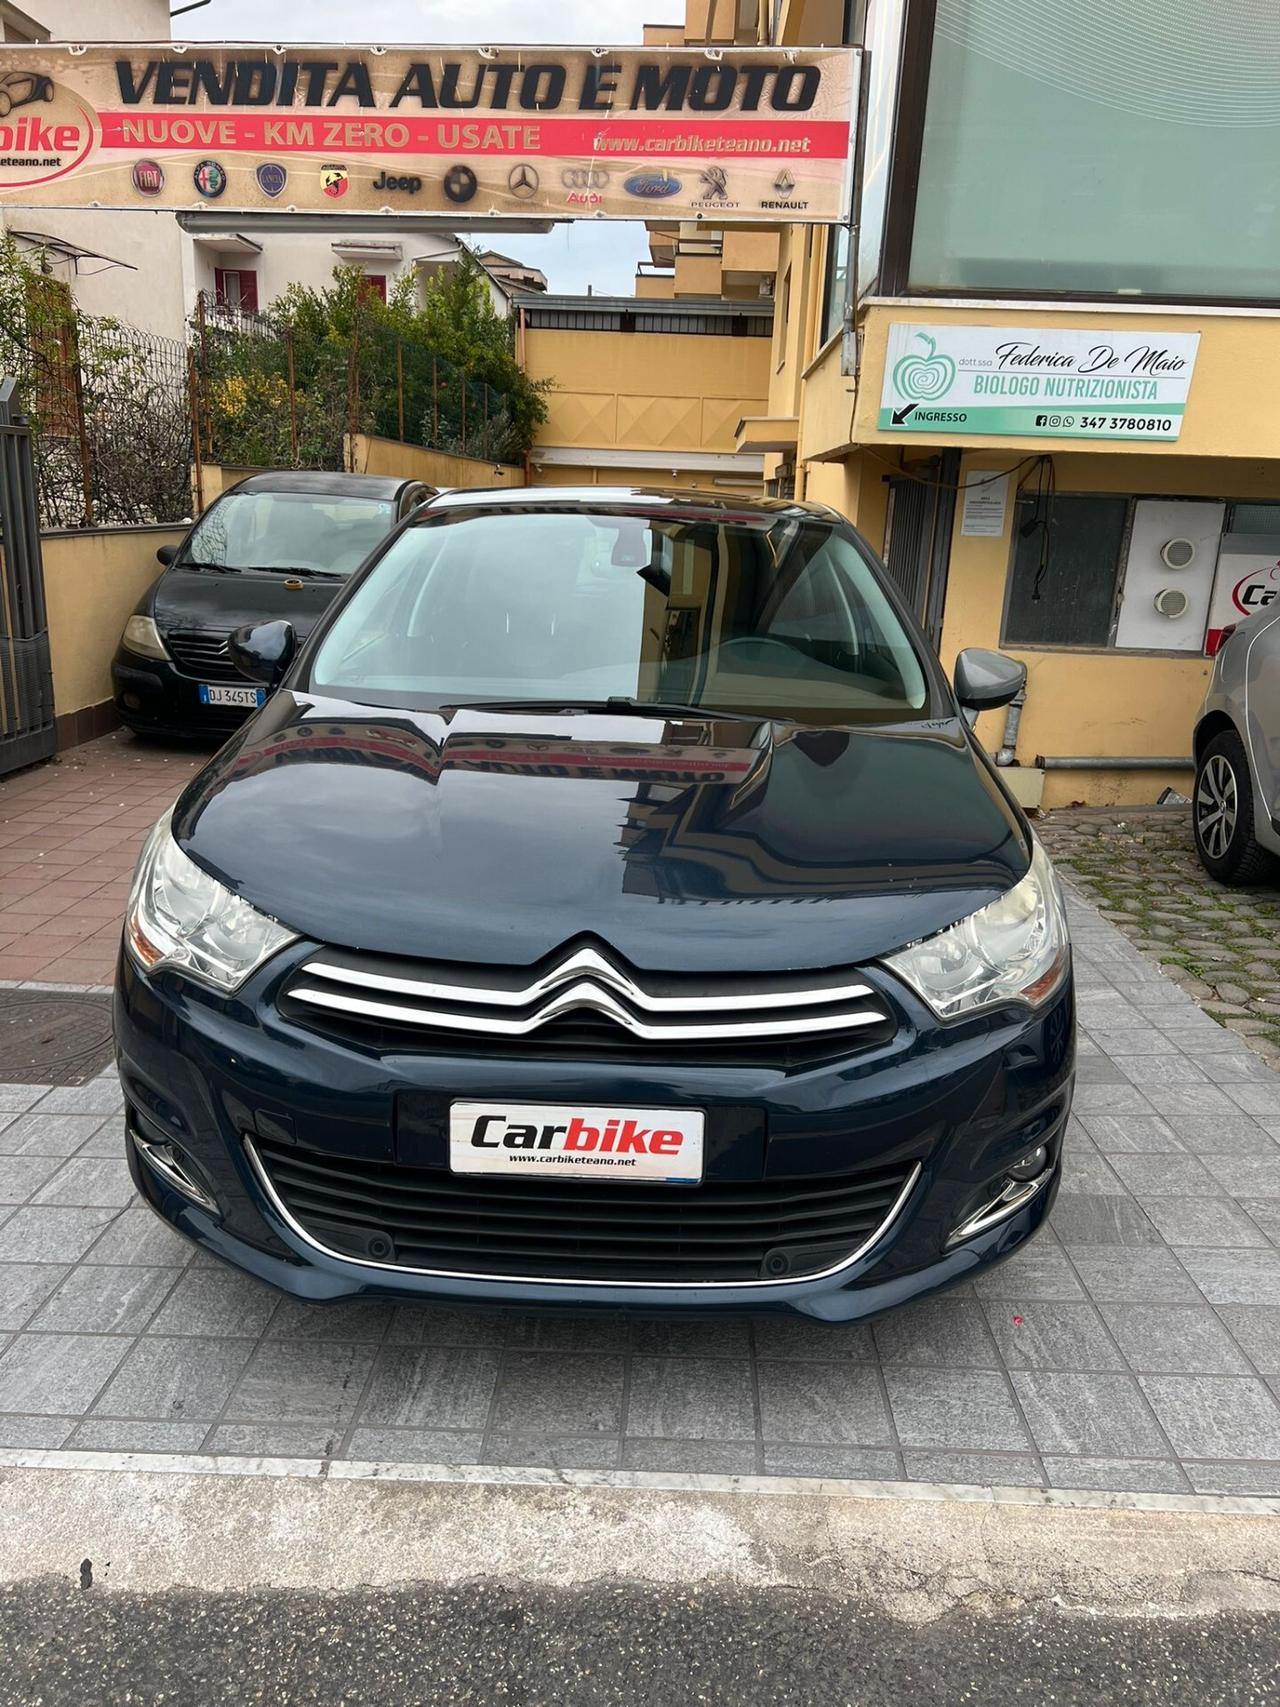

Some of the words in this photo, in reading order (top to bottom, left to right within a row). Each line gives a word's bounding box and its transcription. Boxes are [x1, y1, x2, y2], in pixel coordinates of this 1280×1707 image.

[115, 61, 377, 108] VENDITA
[390, 63, 567, 110] AUTO
[579, 65, 622, 110] E
[630, 65, 821, 111] MOTO
[122, 119, 237, 145] NUOVE
[264, 121, 314, 146] KM
[323, 122, 409, 148] ZERO
[437, 125, 541, 150] USATE
[595, 136, 811, 153] www.carbiketeano.net
[138, 171, 158, 188] FIAT
[373, 171, 422, 194] Jeep
[636, 179, 670, 194] Ford
[567, 191, 603, 204] Audi
[691, 201, 740, 209] PEUGEOT
[761, 201, 809, 209] RENAULT
[995, 341, 1076, 371] Federica
[1078, 345, 1120, 373] De
[1123, 345, 1190, 376] Maio
[974, 376, 1039, 396] BIOLOGO
[1045, 377, 1158, 401] NUTRIZIONISTA
[914, 411, 968, 423] INGRESSO
[1080, 416, 1107, 429] 347
[1109, 417, 1172, 432] 3780810
[471, 1115, 684, 1155] Carbike
[509, 1154, 637, 1167] www.carbiketeano.net
